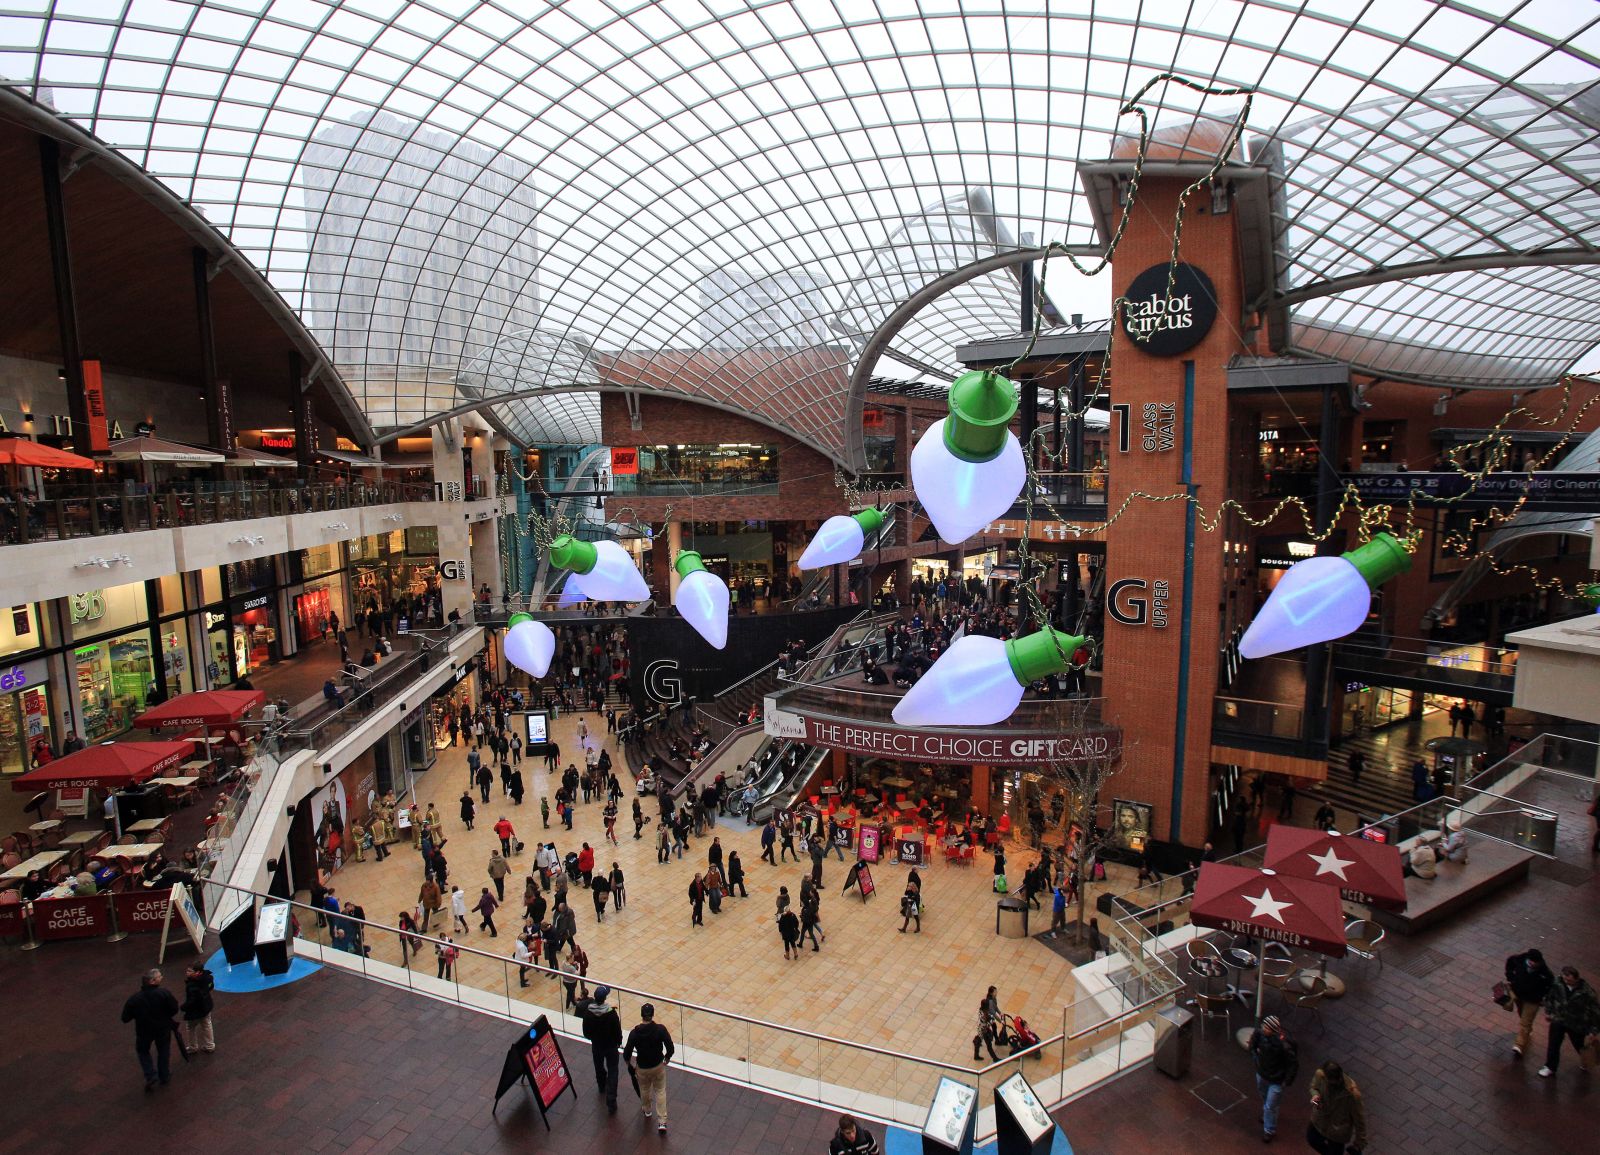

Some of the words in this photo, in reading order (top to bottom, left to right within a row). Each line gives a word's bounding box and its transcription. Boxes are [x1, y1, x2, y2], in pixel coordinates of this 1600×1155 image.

[1129, 294, 1192, 316] cabot
[1127, 313, 1193, 332] circus
[1112, 403, 1131, 452] 1
[1143, 402, 1157, 452] GLASS
[1159, 402, 1176, 451] WALK
[1259, 431, 1279, 440] OSTA
[262, 436, 293, 448] Nando's
[1339, 479, 1440, 488] OWCASE
[441, 560, 458, 580] G
[458, 560, 466, 580] UPPER
[244, 596, 267, 610] SWAROSKI
[1107, 578, 1148, 625] G
[1152, 580, 1169, 628] UPPER
[212, 613, 225, 623] Store
[456, 665, 467, 681] BANK
[644, 660, 682, 704] G
[181, 717, 204, 725] ROUGE
[812, 721, 841, 743] THE
[845, 727, 919, 752] PERFECT
[924, 737, 1003, 757] CHOICE
[164, 753, 180, 766] ROUGE
[70, 779, 99, 788] ROUGE
[1342, 888, 1365, 903] NGER
[48, 916, 95, 930] ROUGE
[1231, 919, 1251, 934] PRET
[1254, 926, 1260, 936] A
[1263, 927, 1301, 945] MANGER
